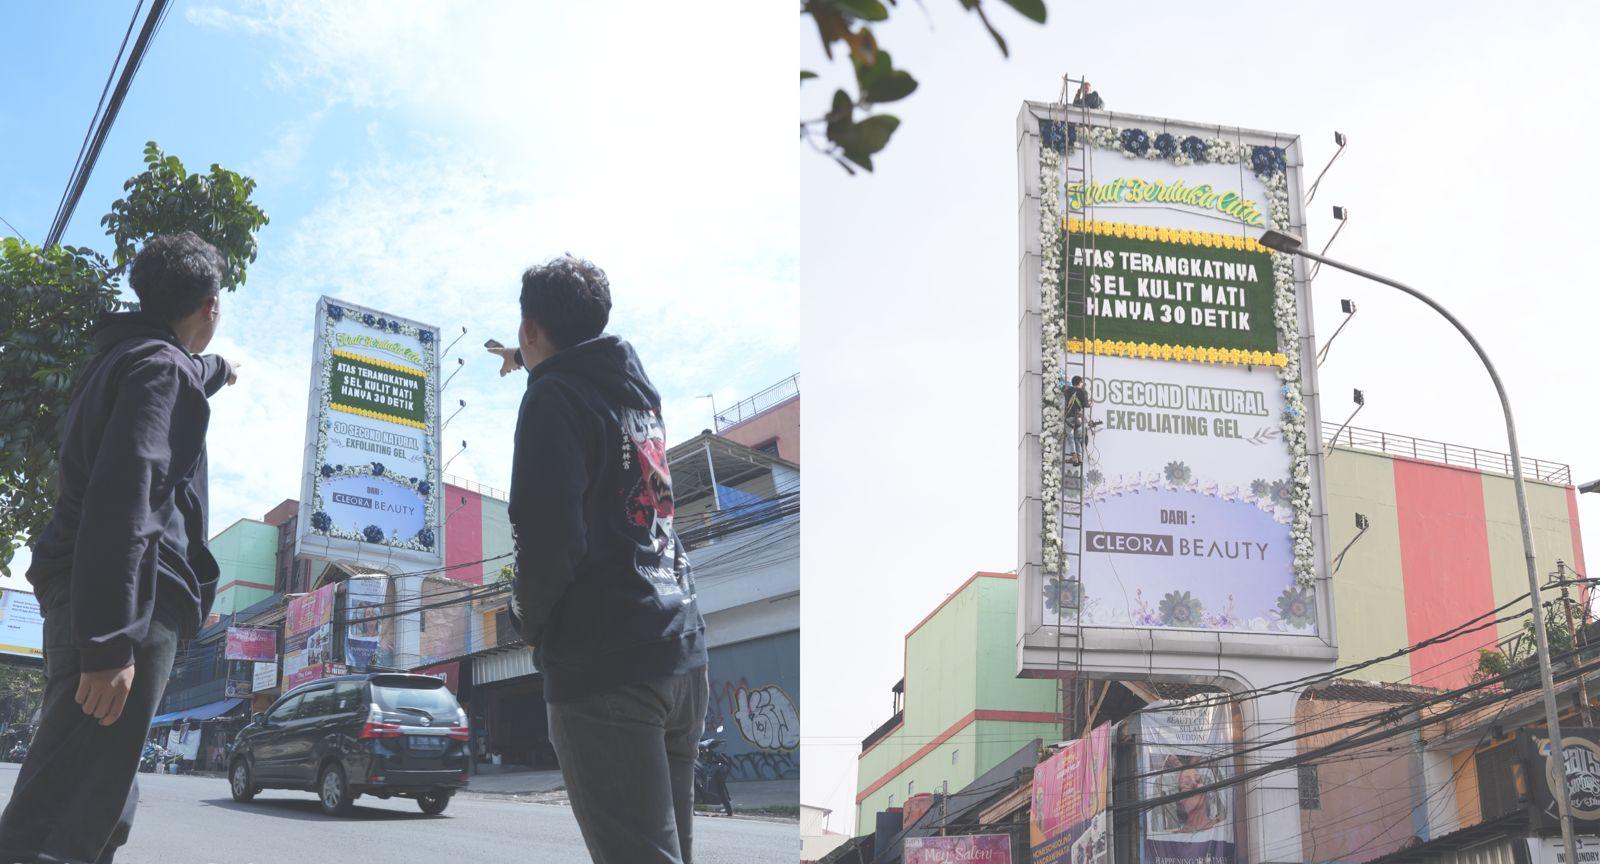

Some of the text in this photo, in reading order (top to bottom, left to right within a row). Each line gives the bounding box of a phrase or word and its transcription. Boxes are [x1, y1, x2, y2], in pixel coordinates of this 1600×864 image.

[1124, 176, 1218, 210] Berduka
[1216, 190, 1266, 226] Cita
[1073, 248, 1258, 282] ATAS TERANGKATNYA
[1090, 274, 1246, 307] SEL KULIT MATI
[1086, 297, 1250, 331] HANYA 30 DETIK
[337, 362, 418, 389] ATAS TERANGKATNYA
[344, 376, 412, 399] SEL KULIT MATI
[341, 385, 414, 411] HANYA 30 DETIK
[1109, 379, 1183, 409] SECOND
[1186, 385, 1269, 417] NATURAL
[334, 421, 419, 451] 30 SECOND NATURAL
[1106, 409, 1242, 439] EXFOLIATING GEL
[346, 438, 406, 459] EXFOLIATING GEL
[335, 494, 415, 515] CLEORA BEAUTY
[1160, 509, 1187, 525] DARI
[1092, 534, 1269, 560] CLEORA BEAUTY
